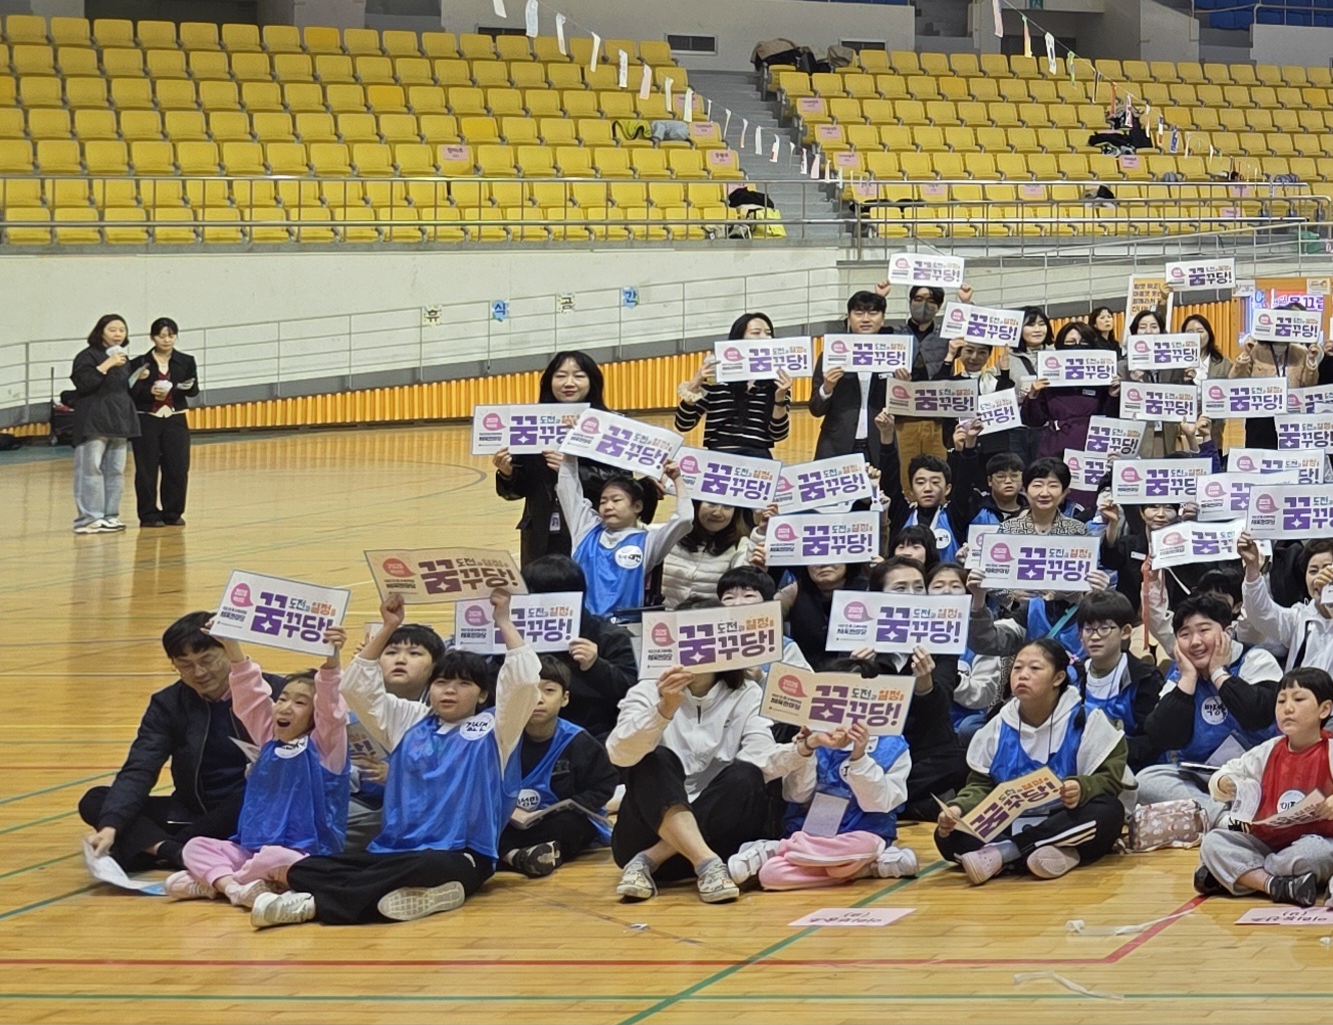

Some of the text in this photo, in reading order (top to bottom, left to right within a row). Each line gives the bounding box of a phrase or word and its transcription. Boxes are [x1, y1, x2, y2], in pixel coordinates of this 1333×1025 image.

[425, 289, 638, 322] 휴 식 공 간
[596, 426, 669, 469] 꿈꾸당!
[701, 463, 771, 501] 꿈꾸당!
[802, 526, 872, 556] 꿈꾸당!
[1017, 547, 1091, 582] 꿈꾸당!
[875, 606, 961, 643] 꿈꾸당!
[678, 623, 775, 667] 꿈꾸당!
[808, 685, 900, 726] 꿈꾸당!
